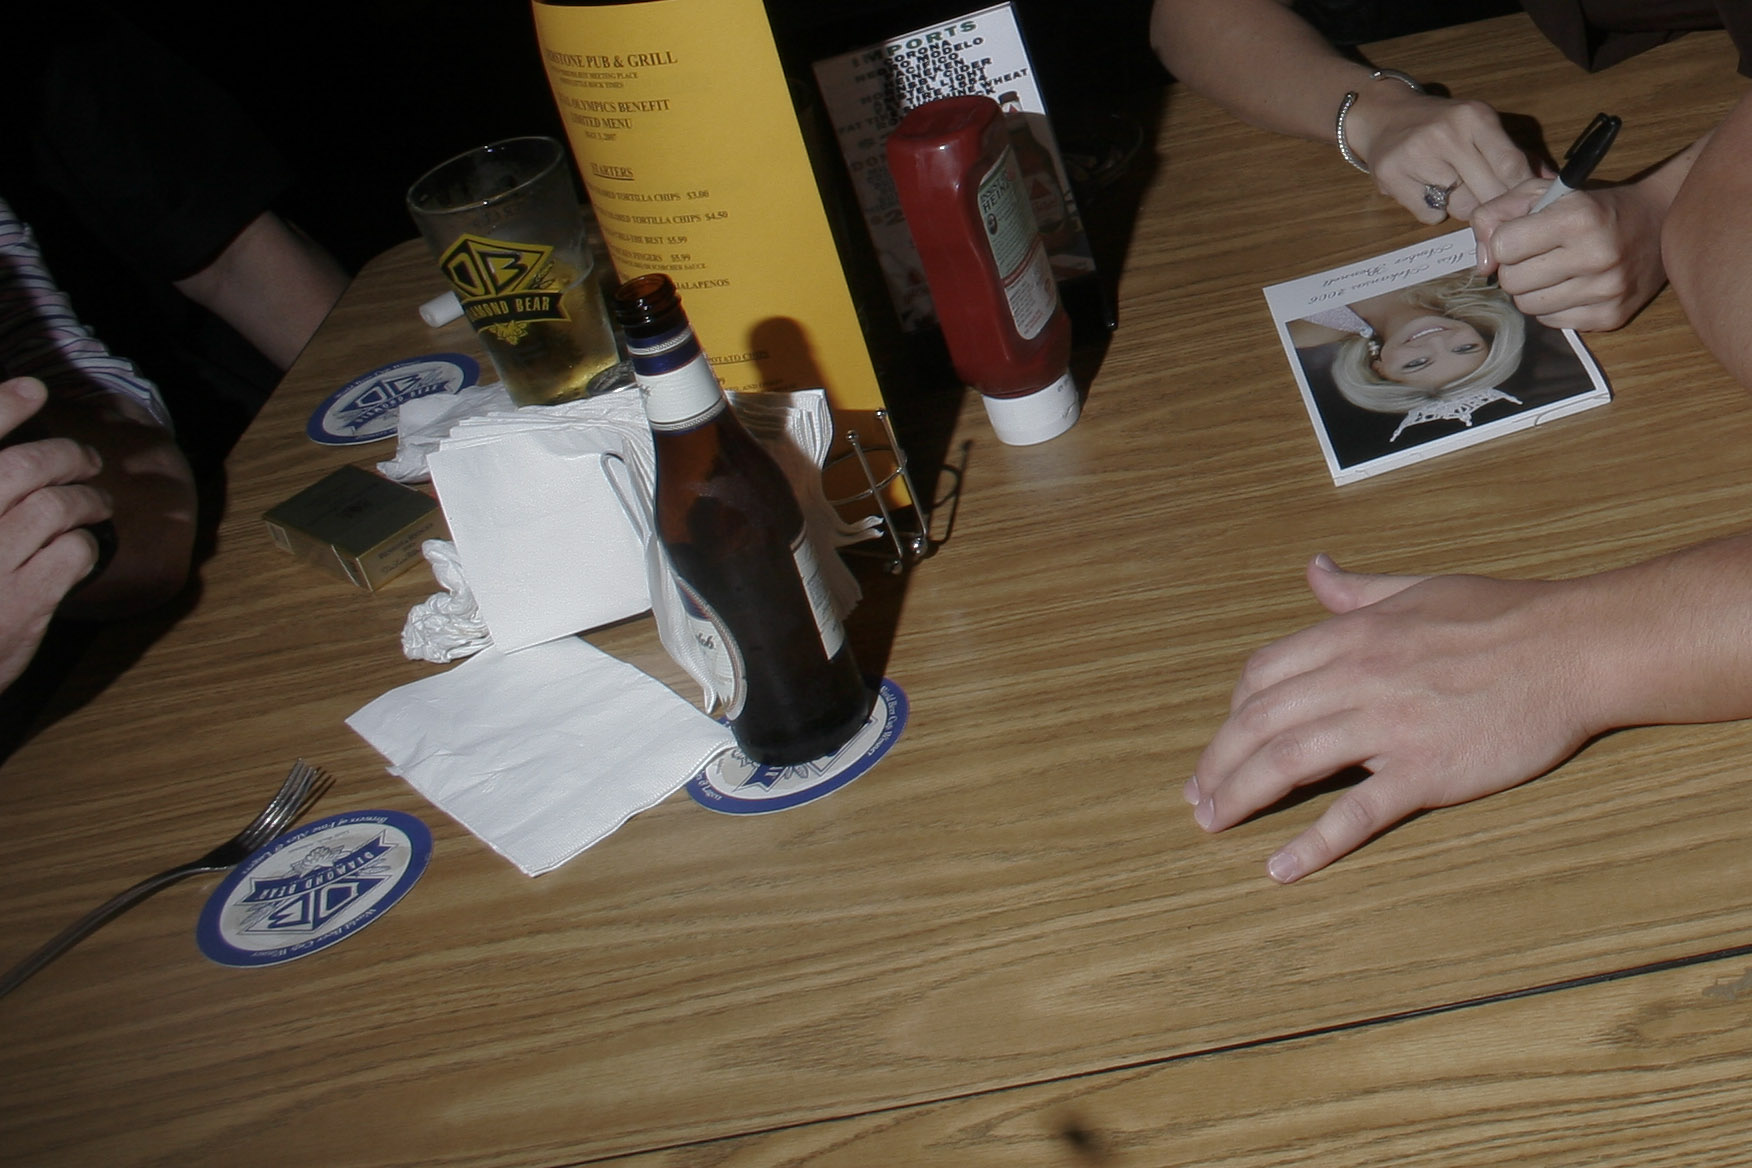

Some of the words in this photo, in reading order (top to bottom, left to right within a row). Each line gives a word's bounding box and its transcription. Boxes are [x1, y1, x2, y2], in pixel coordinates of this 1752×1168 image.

[851, 20, 977, 69] IMPORTS
[916, 37, 984, 64] MODELO
[586, 55, 611, 69] PUB
[613, 56, 624, 68] &
[627, 51, 679, 69] GRILL
[884, 39, 952, 69] CORONA
[940, 67, 985, 87] LIGHT
[943, 57, 992, 79] CIDER
[979, 68, 1028, 89] WHEAT
[617, 98, 671, 113] BENEFIT
[906, 88, 943, 105] TIRE
[601, 118, 633, 129] MENU
[591, 163, 634, 179] STARTERS
[654, 193, 681, 202] CHIPS
[633, 215, 672, 225] TORTILLA
[673, 212, 702, 224] CHIPS
[514, 296, 551, 313] BEAR
[711, 353, 741, 364] OTATO
[305, 851, 375, 890] DIAMOND
[260, 882, 297, 900] BEAR
